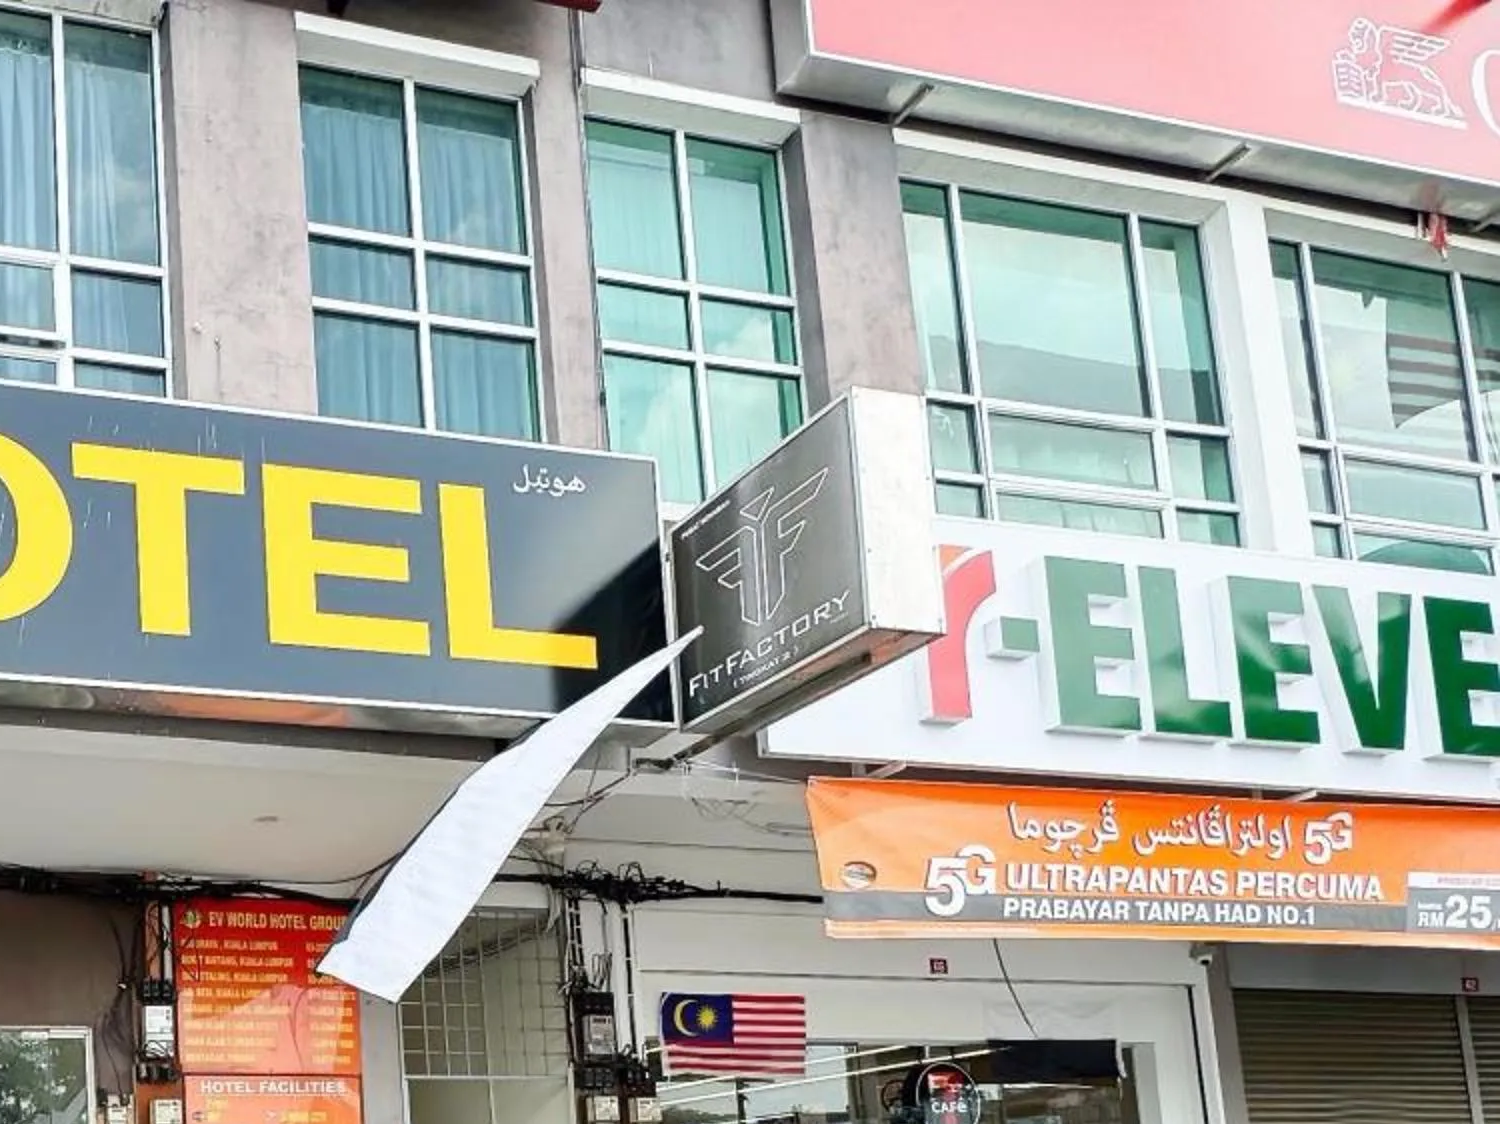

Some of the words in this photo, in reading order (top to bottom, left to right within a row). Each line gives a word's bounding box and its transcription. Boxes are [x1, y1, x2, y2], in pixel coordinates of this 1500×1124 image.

[1303, 812, 1354, 866] 5G
[924, 845, 997, 917] 5G
[1005, 862, 1227, 899] ULTRAPANTAS
[1237, 871, 1385, 901] PERCUMA
[226, 912, 267, 929] WORLD
[270, 914, 307, 930] HOTEL
[1003, 897, 1130, 922] PRABAYAR
[1137, 900, 1210, 923] TANPA
[1215, 903, 1261, 924] HAD
[1267, 906, 1316, 926] NO.1
[200, 1080, 256, 1094] HOTEL
[259, 1080, 349, 1095] FACILITIES
